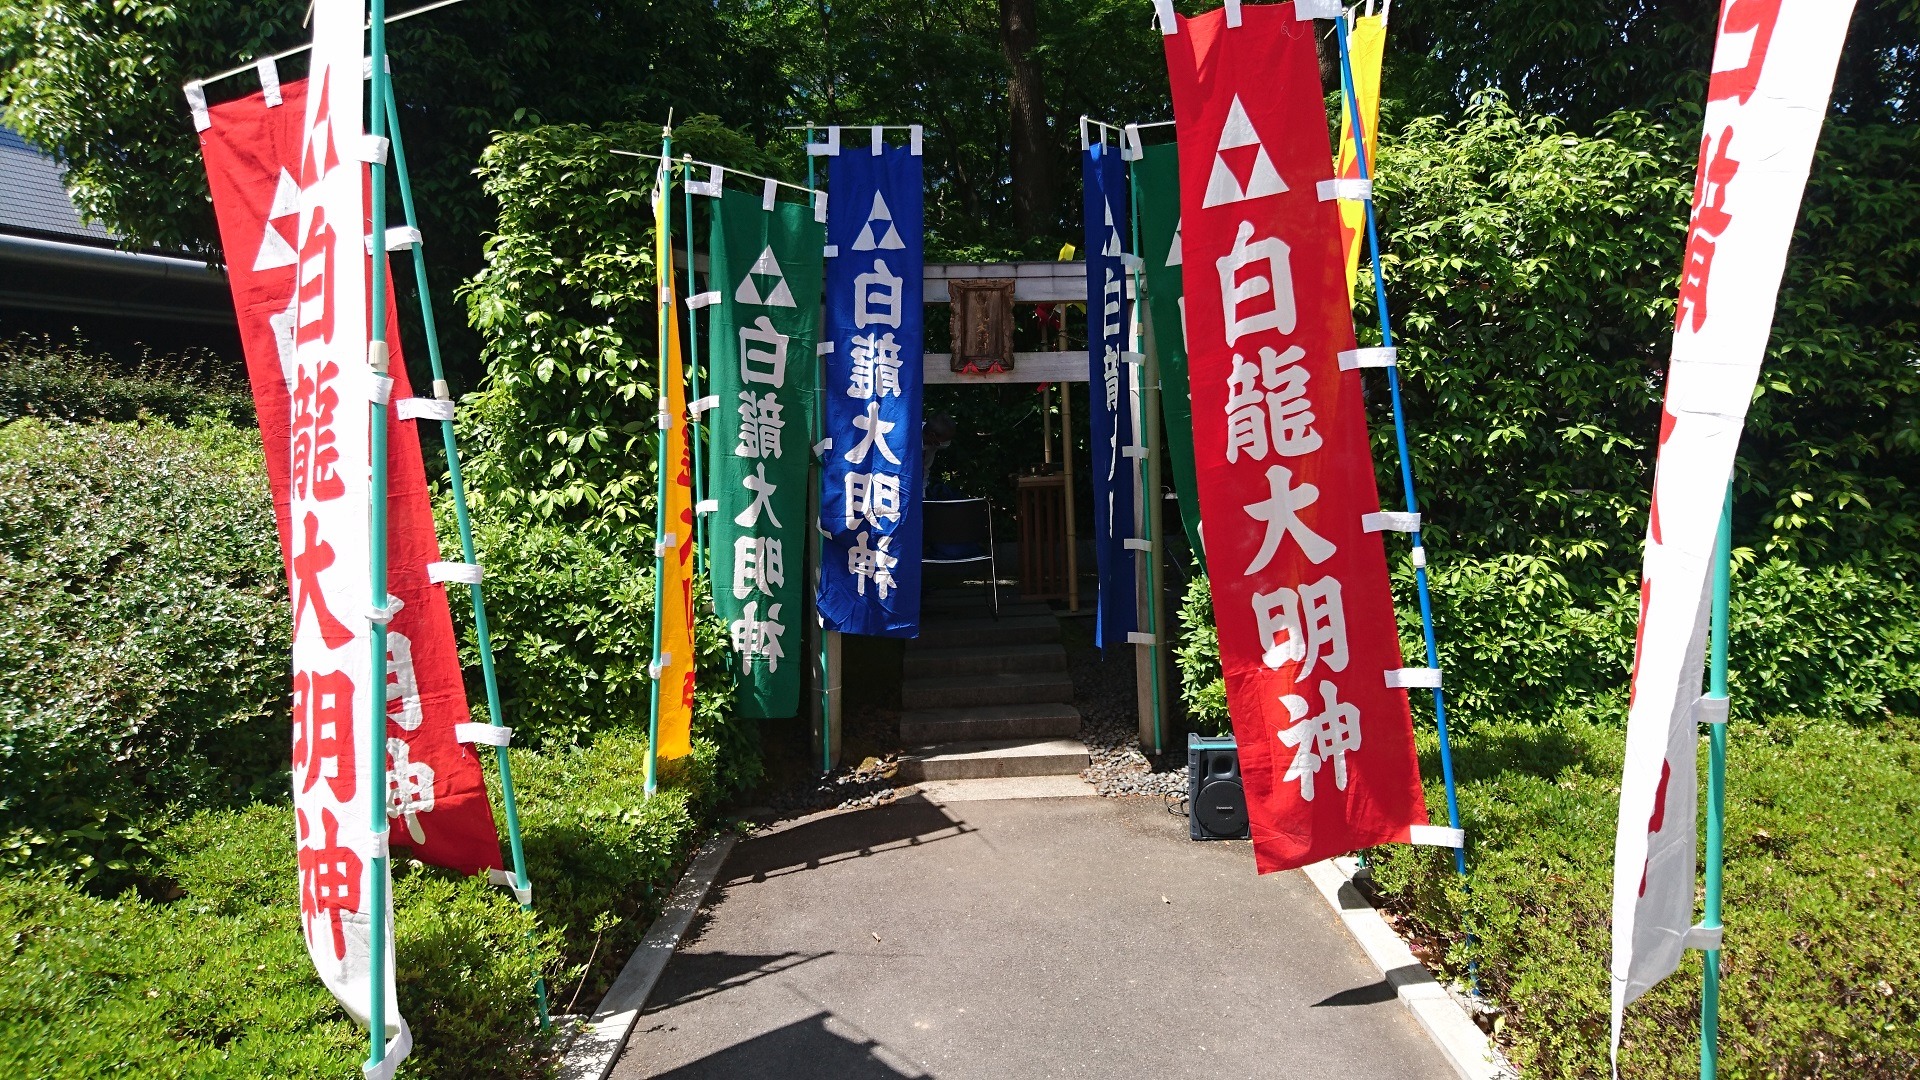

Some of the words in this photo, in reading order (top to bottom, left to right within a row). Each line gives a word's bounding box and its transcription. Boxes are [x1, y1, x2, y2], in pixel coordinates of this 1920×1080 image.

[292, 206, 364, 961] 白龍大明神
[1215, 220, 1362, 802] 白龍大明神
